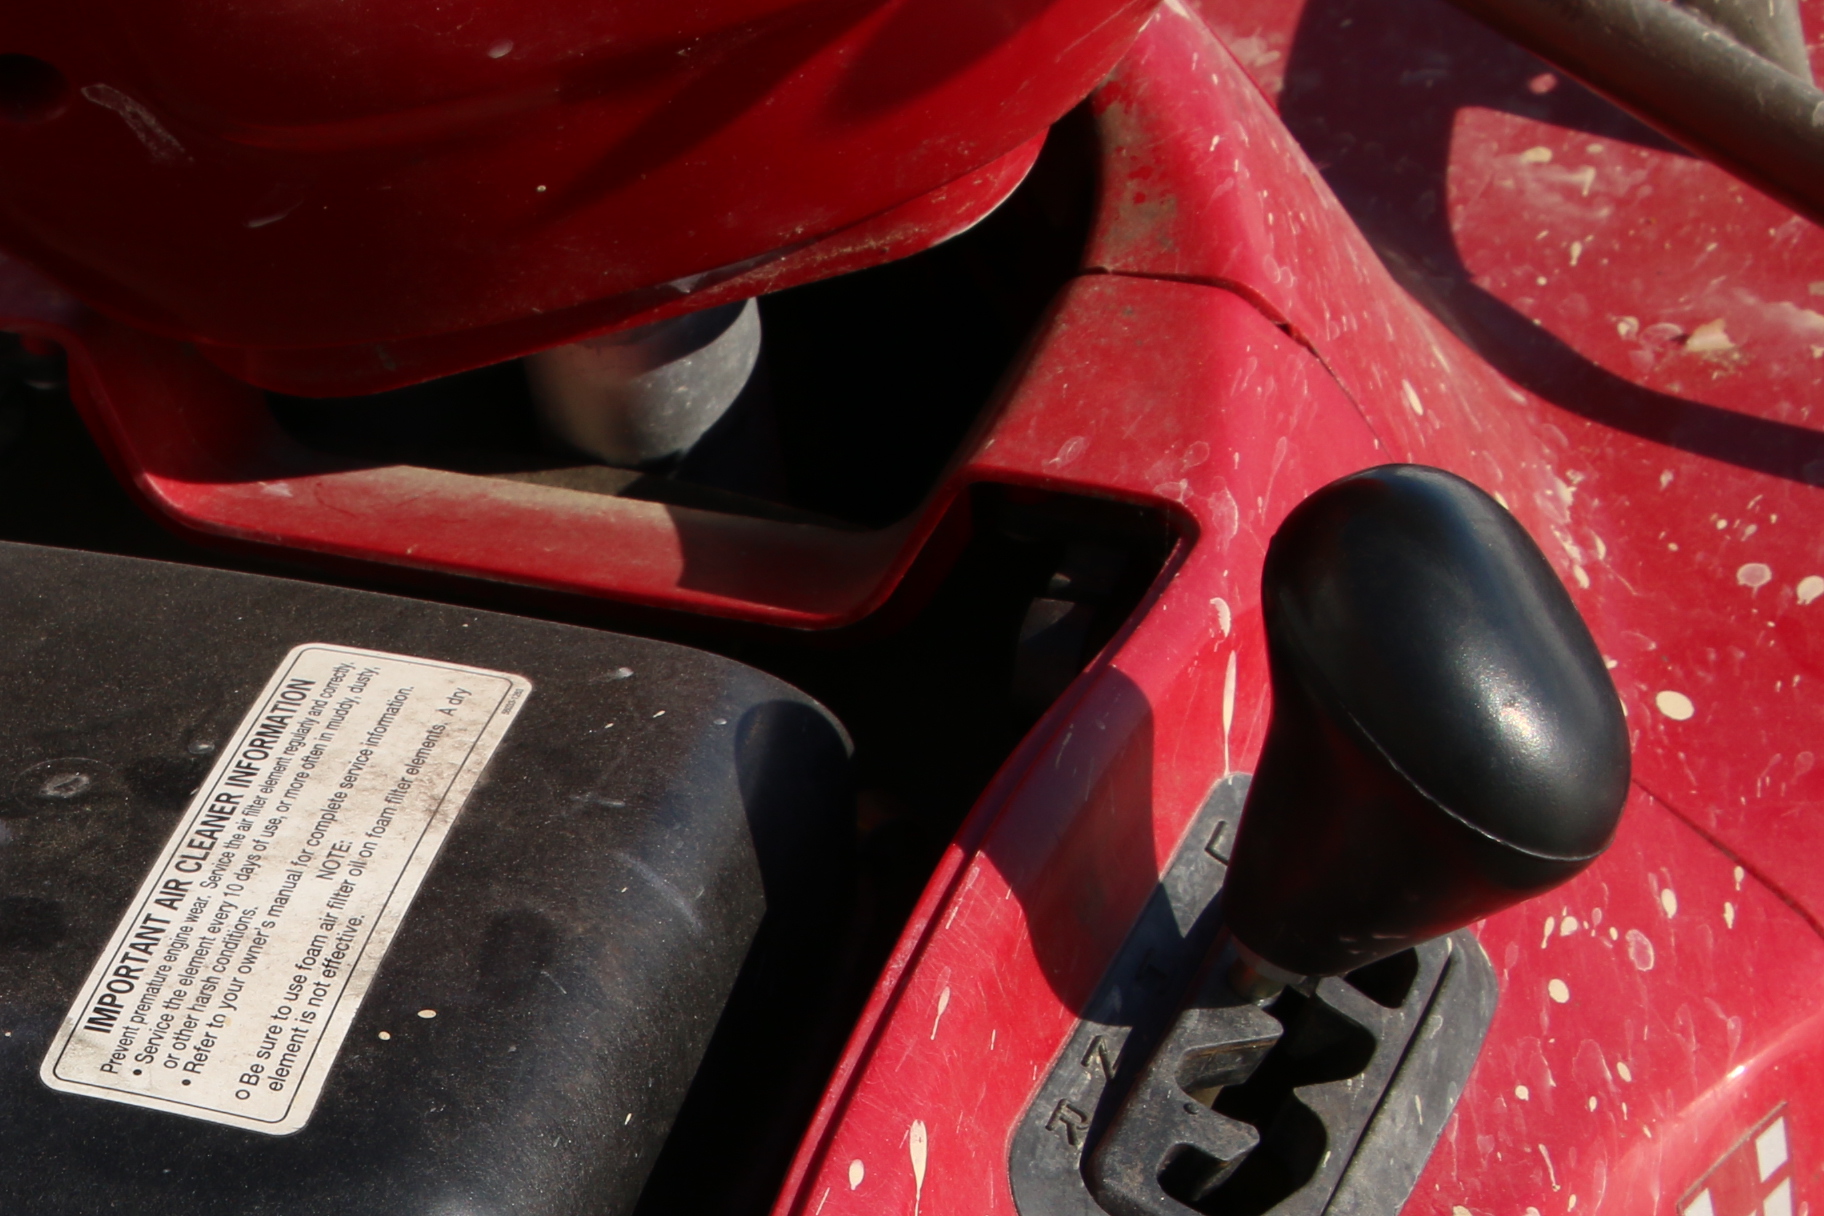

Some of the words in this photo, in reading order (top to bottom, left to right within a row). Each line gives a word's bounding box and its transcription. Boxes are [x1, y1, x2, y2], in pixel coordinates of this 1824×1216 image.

[320, 663, 356, 698] correctly.
[348, 668, 380, 693] dusty,
[308, 700, 328, 716] and
[447, 688, 472, 705] dry
[325, 697, 361, 730] muddy,
[283, 717, 320, 755] regularly
[319, 733, 334, 742] in
[404, 723, 448, 775] elements.
[301, 744, 327, 770] often
[259, 757, 292, 793] element
[284, 772, 310, 799] more
[384, 777, 414, 804] filter
[241, 795, 268, 817] filter
[276, 800, 292, 812] or
[237, 818, 254, 832] air
[260, 816, 287, 837] use,
[365, 807, 397, 838] foam
[83, 913, 171, 1033] IMPORTANT
[153, 879, 193, 911] AIR
[174, 792, 244, 873] CLEANER
[225, 675, 315, 788] INFORMATION
[223, 834, 246, 849] the
[252, 839, 269, 851] of
[359, 842, 377, 858] on
[199, 852, 235, 889] Service
[234, 854, 262, 881] days
[316, 840, 352, 880] NOTE:
[347, 860, 367, 876] oil
[182, 1031, 217, 1074] Refer
[205, 1014, 226, 1028] to
[218, 977, 245, 1011] your
[237, 921, 275, 974] owner's
[267, 869, 303, 917] manual
[290, 849, 314, 867] for
[306, 792, 347, 846] complete
[339, 749, 373, 789] service
[365, 687, 413, 747] information.
[223, 884, 244, 897] 10
[326, 879, 356, 909] filter
[184, 896, 211, 922] wear.
[207, 901, 238, 934] every
[320, 912, 338, 932] air
[163, 926, 193, 962] engine
[295, 935, 328, 971] foam
[321, 915, 365, 978] effective.
[178, 936, 216, 986] element
[130, 965, 172, 1025] premature
[162, 990, 187, 1010] the
[163, 1053, 180, 1069] or
[172, 1014, 199, 1050] other
[186, 976, 221, 1012] harsh
[212, 907, 258, 973] conditions.
[284, 975, 307, 1002] use
[307, 981, 331, 1007] not
[270, 1006, 292, 1020] to
[299, 1011, 316, 1024] is
[100, 1026, 140, 1074] Prevent
[134, 1014, 174, 1064] Service
[256, 1025, 283, 1060] sure
[267, 1027, 309, 1091] element
[239, 1064, 265, 1086] Be
[1045, 1097, 1090, 1148] R
